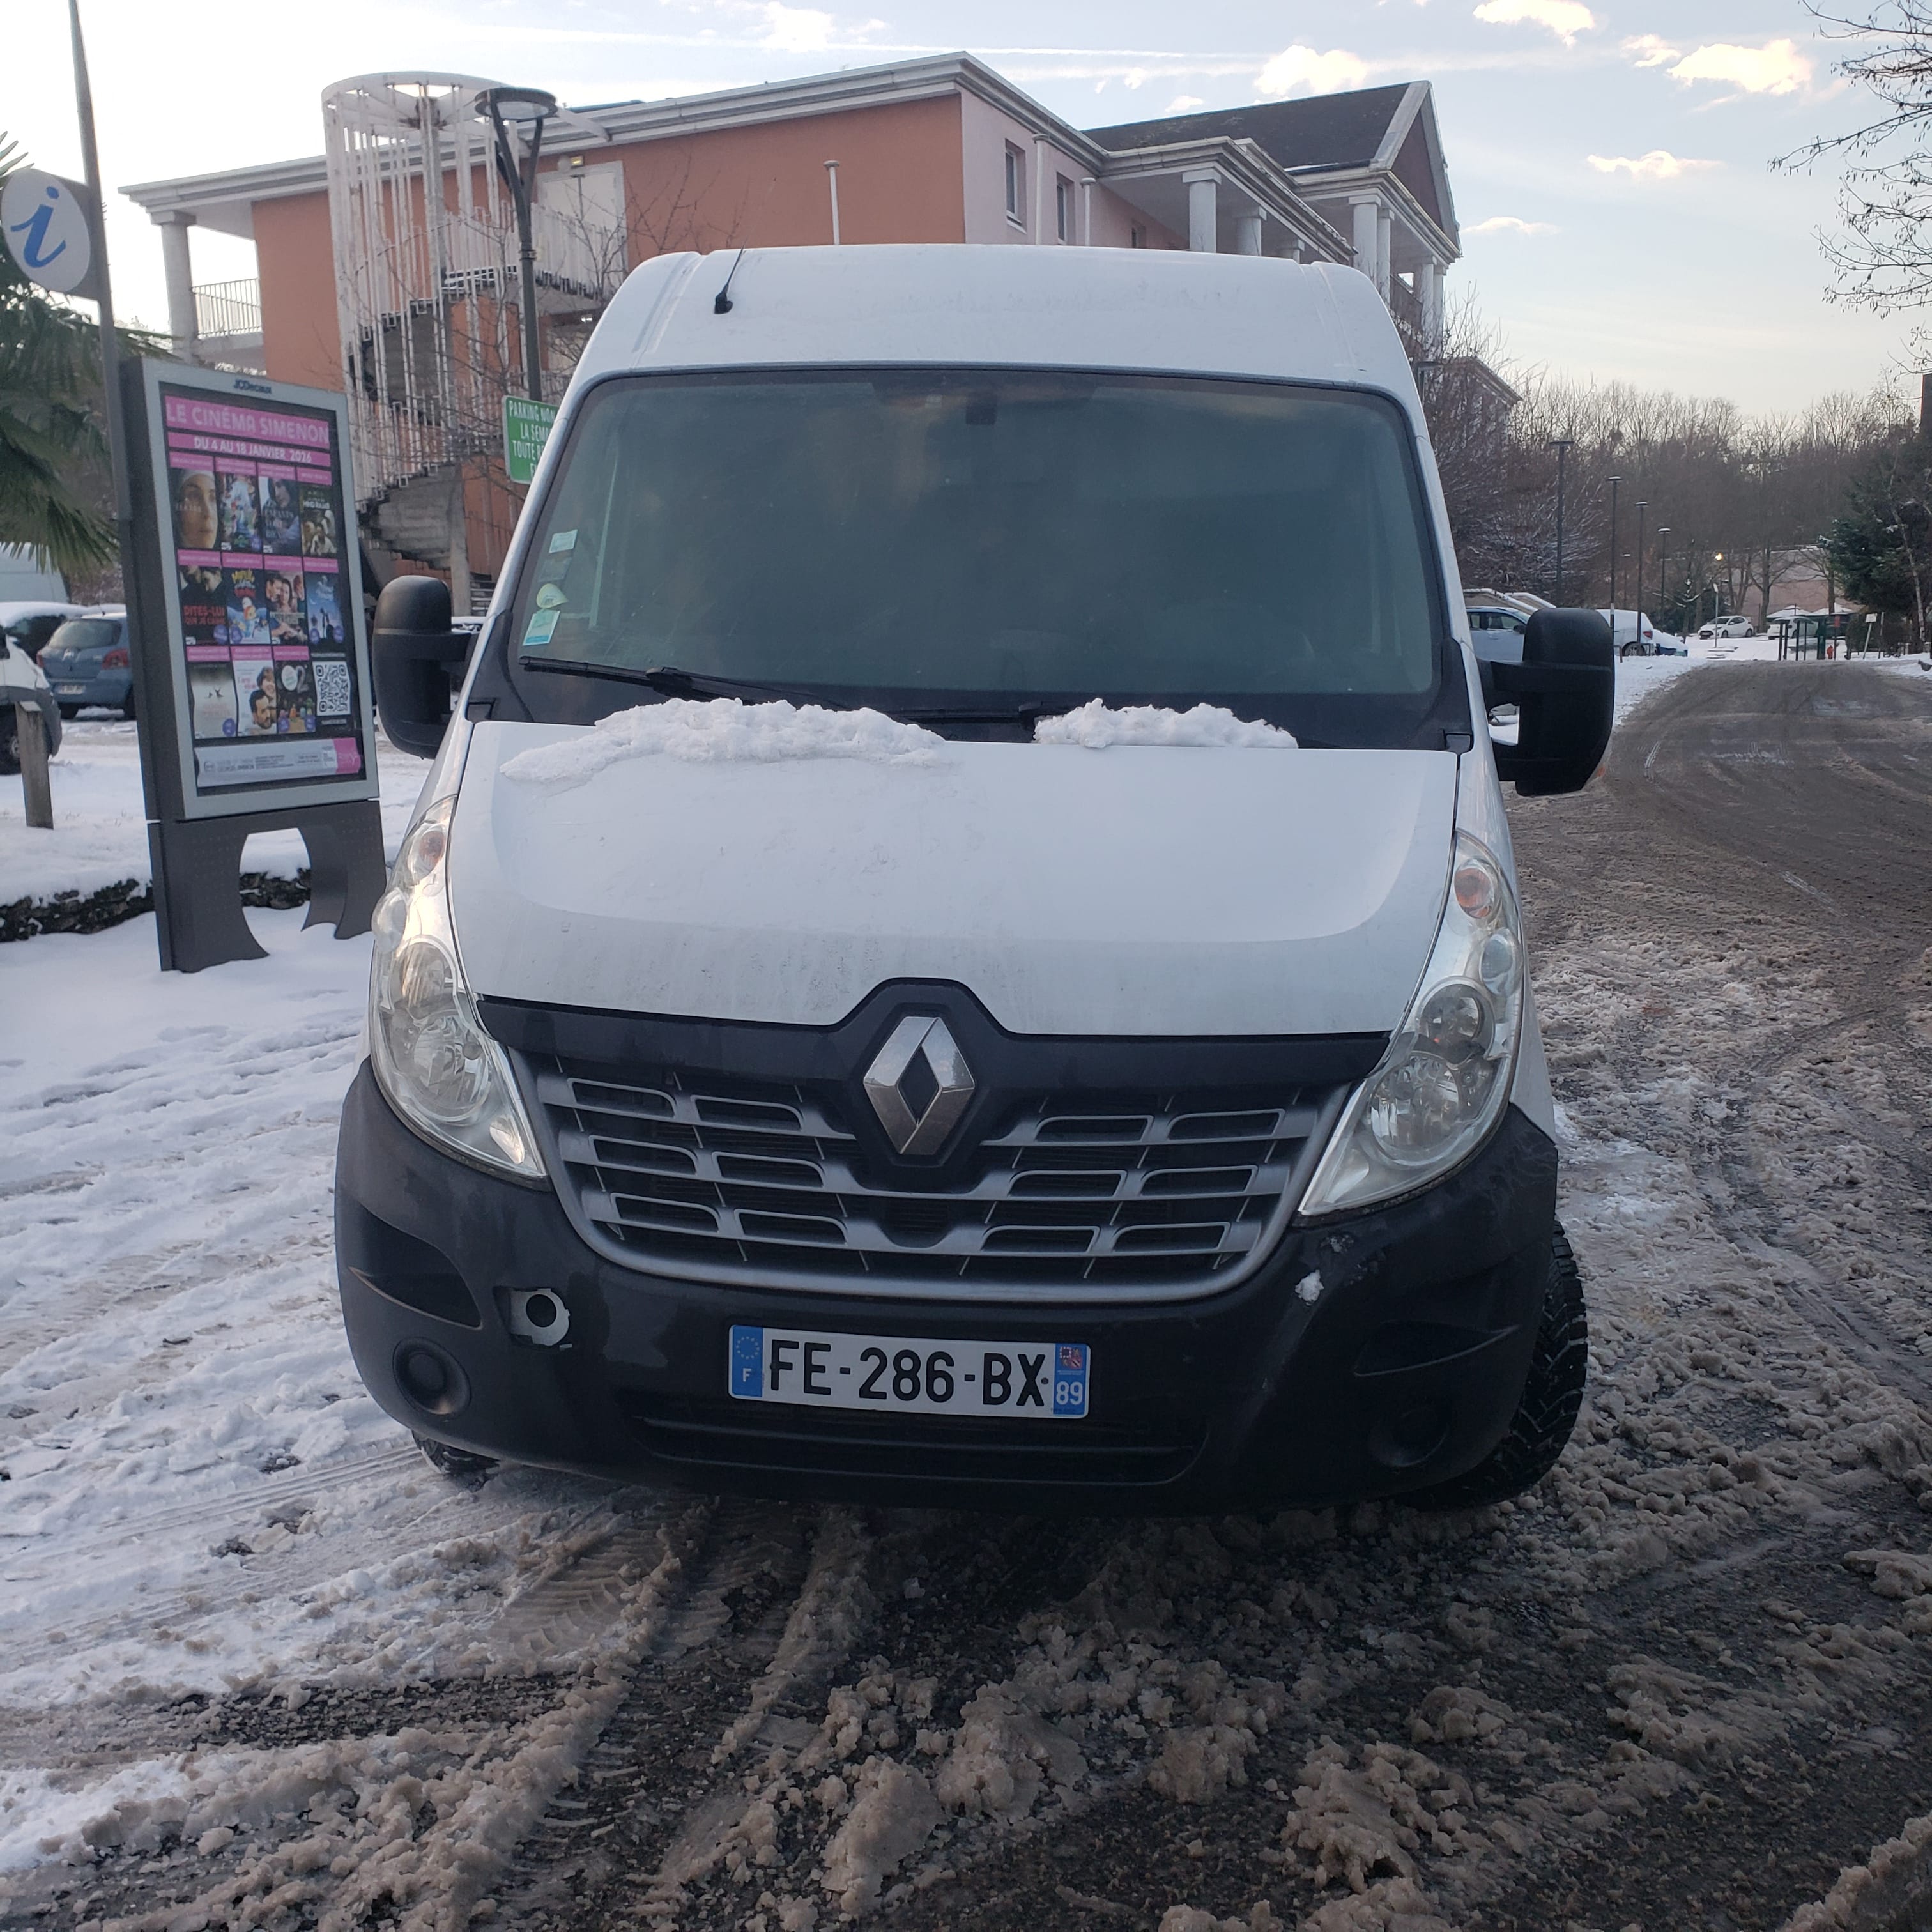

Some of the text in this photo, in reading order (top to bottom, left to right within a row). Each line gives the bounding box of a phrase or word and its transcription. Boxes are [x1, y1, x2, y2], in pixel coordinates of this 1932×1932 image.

[509, 401, 540, 422] PARKING
[165, 403, 329, 443] LE CINÉMA SIMENON
[520, 422, 529, 440] LA
[194, 437, 312, 463] DU 4 AU 18 JANVIER 2026
[512, 441, 536, 461] TOUTE
[743, 1368, 752, 1382] F
[770, 1339, 1046, 1406] FE-286-BX
[1056, 1381, 1083, 1405] 89
